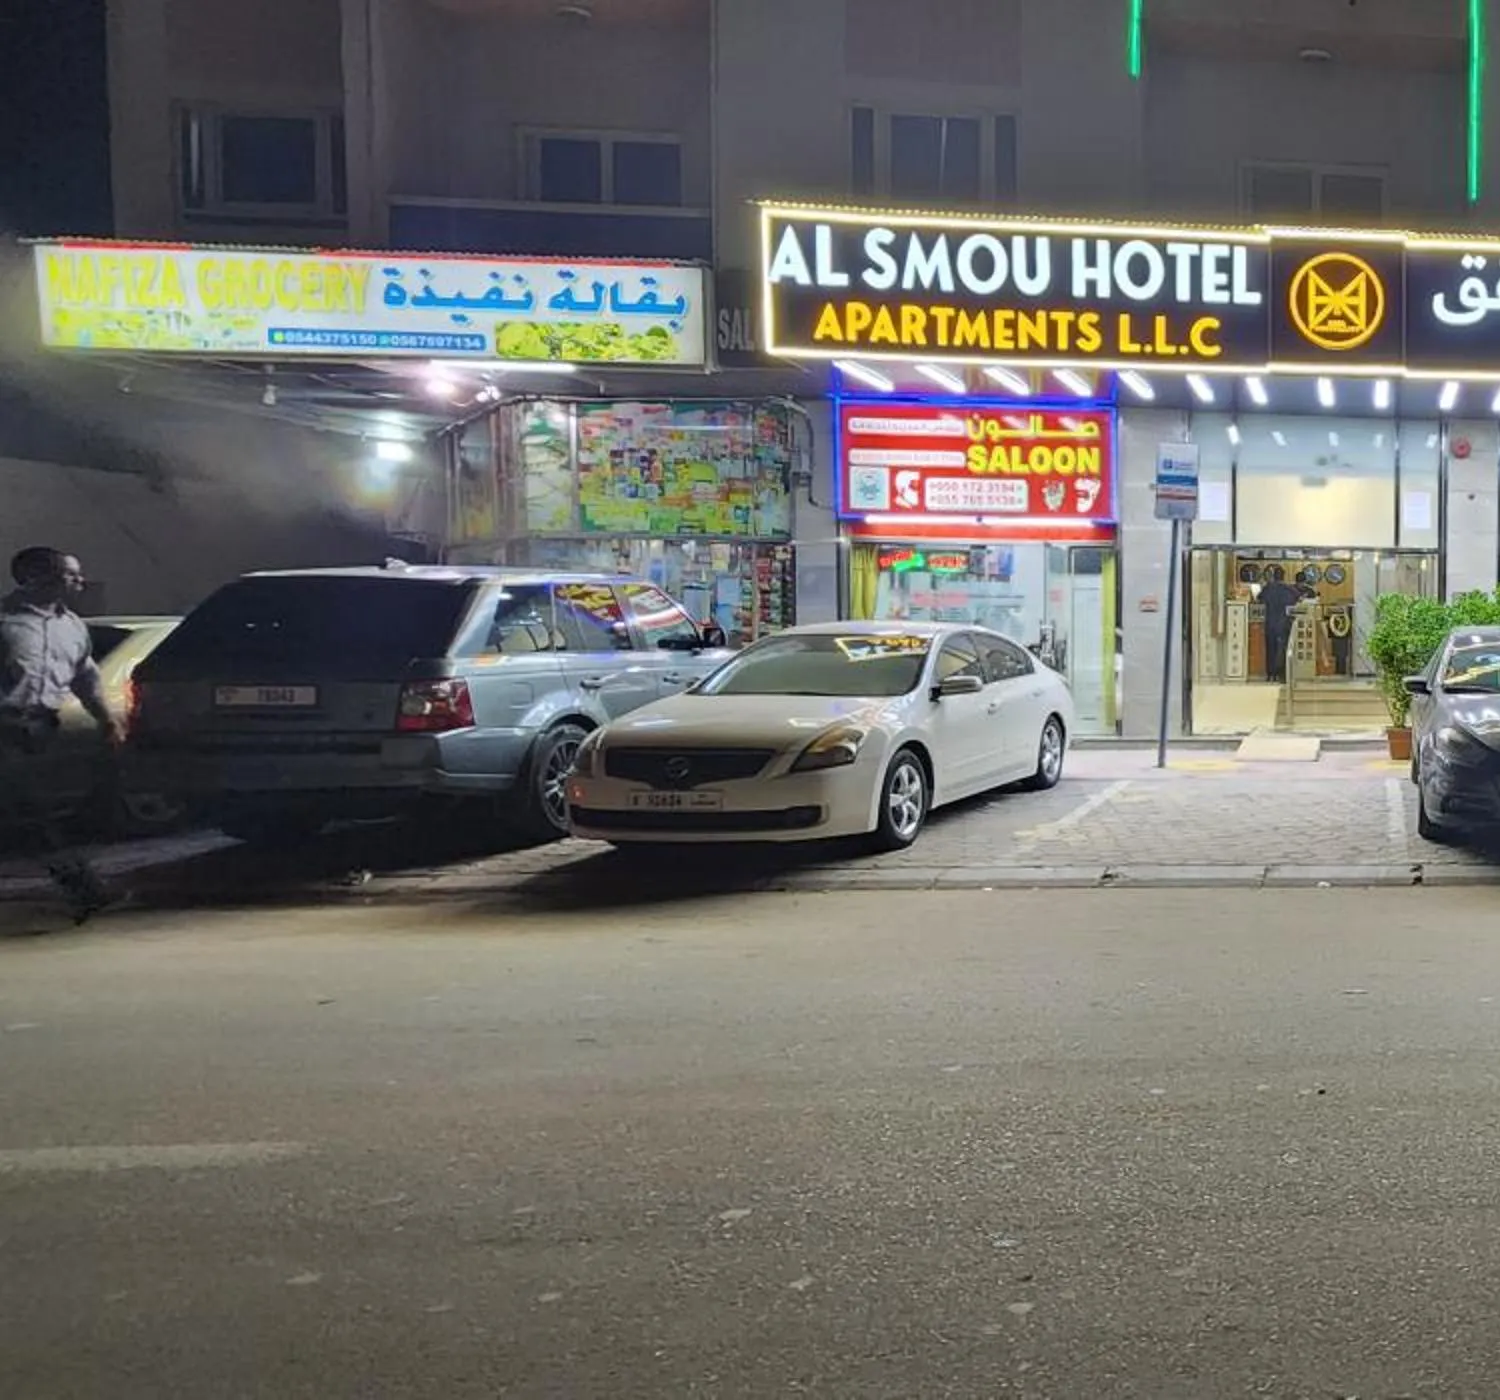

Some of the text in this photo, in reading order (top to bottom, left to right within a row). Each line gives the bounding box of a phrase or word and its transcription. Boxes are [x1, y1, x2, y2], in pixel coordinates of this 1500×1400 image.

[47, 254, 372, 314] NAFIZA GROCERY
[768, 225, 1262, 305] AL SMOU HOTEL
[383, 268, 688, 331] بقالة نفيذة
[813, 301, 1222, 356] APARTMENTS L.L.C
[967, 444, 1101, 475] SALOON
